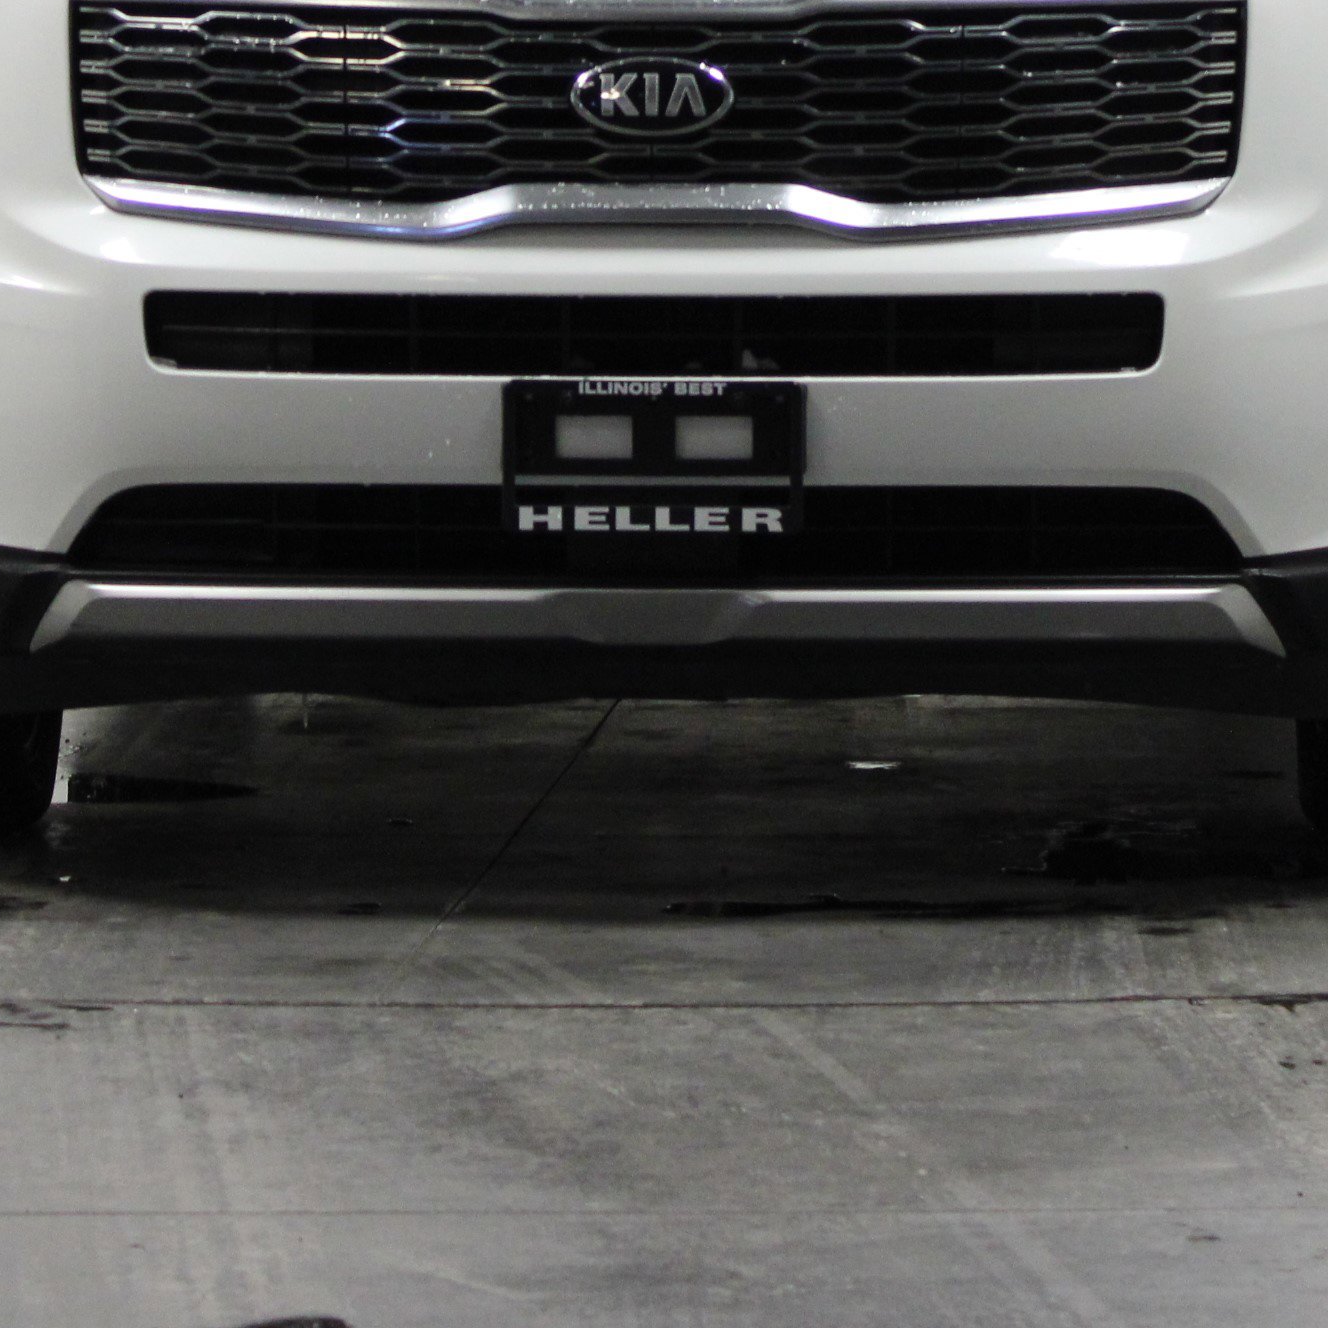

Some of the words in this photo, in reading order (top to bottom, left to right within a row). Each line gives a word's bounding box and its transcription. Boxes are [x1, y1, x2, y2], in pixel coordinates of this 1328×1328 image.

[599, 73, 707, 116] KIA
[674, 381, 727, 396] BEST
[518, 505, 784, 532] HELLER
